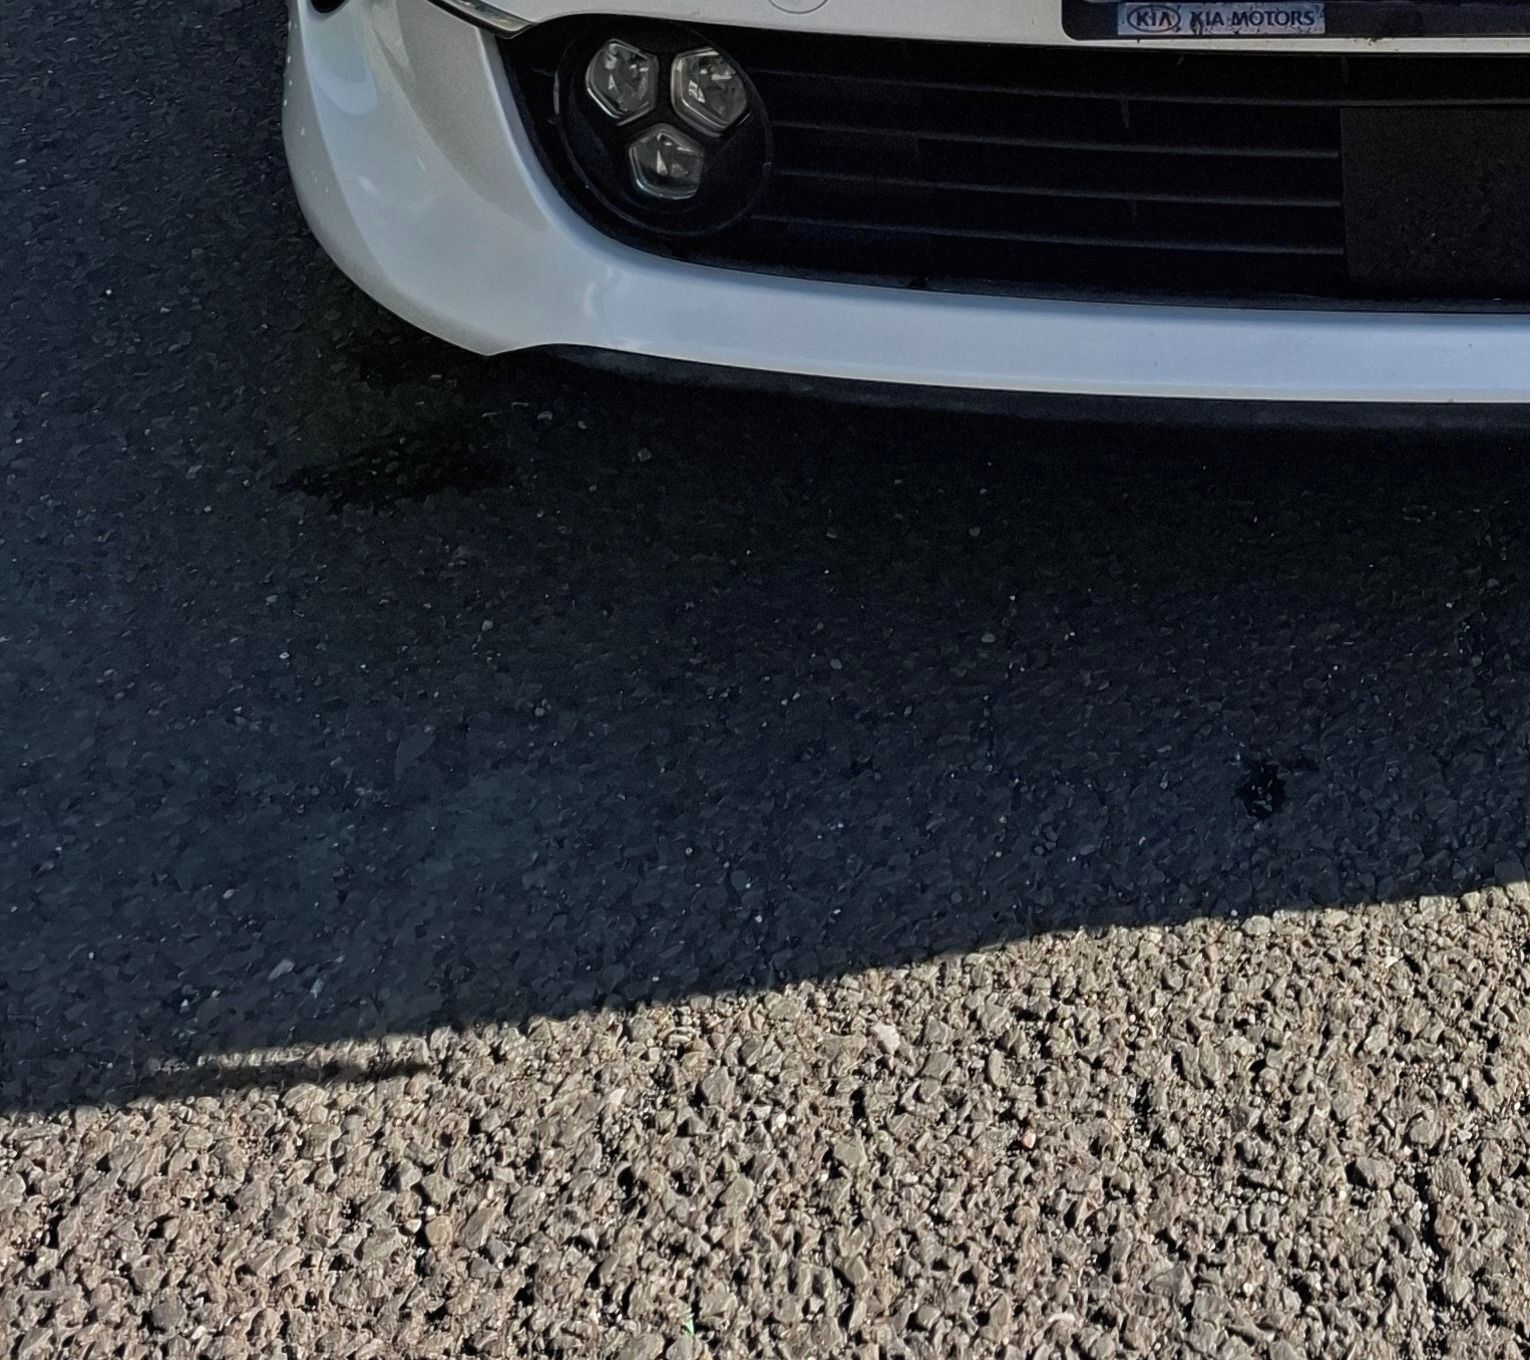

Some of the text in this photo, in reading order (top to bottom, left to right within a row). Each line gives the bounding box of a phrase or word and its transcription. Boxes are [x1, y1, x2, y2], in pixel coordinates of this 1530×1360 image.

[1136, 11, 1173, 27] KIA
[1190, 10, 1315, 27] KIA MOTORS
